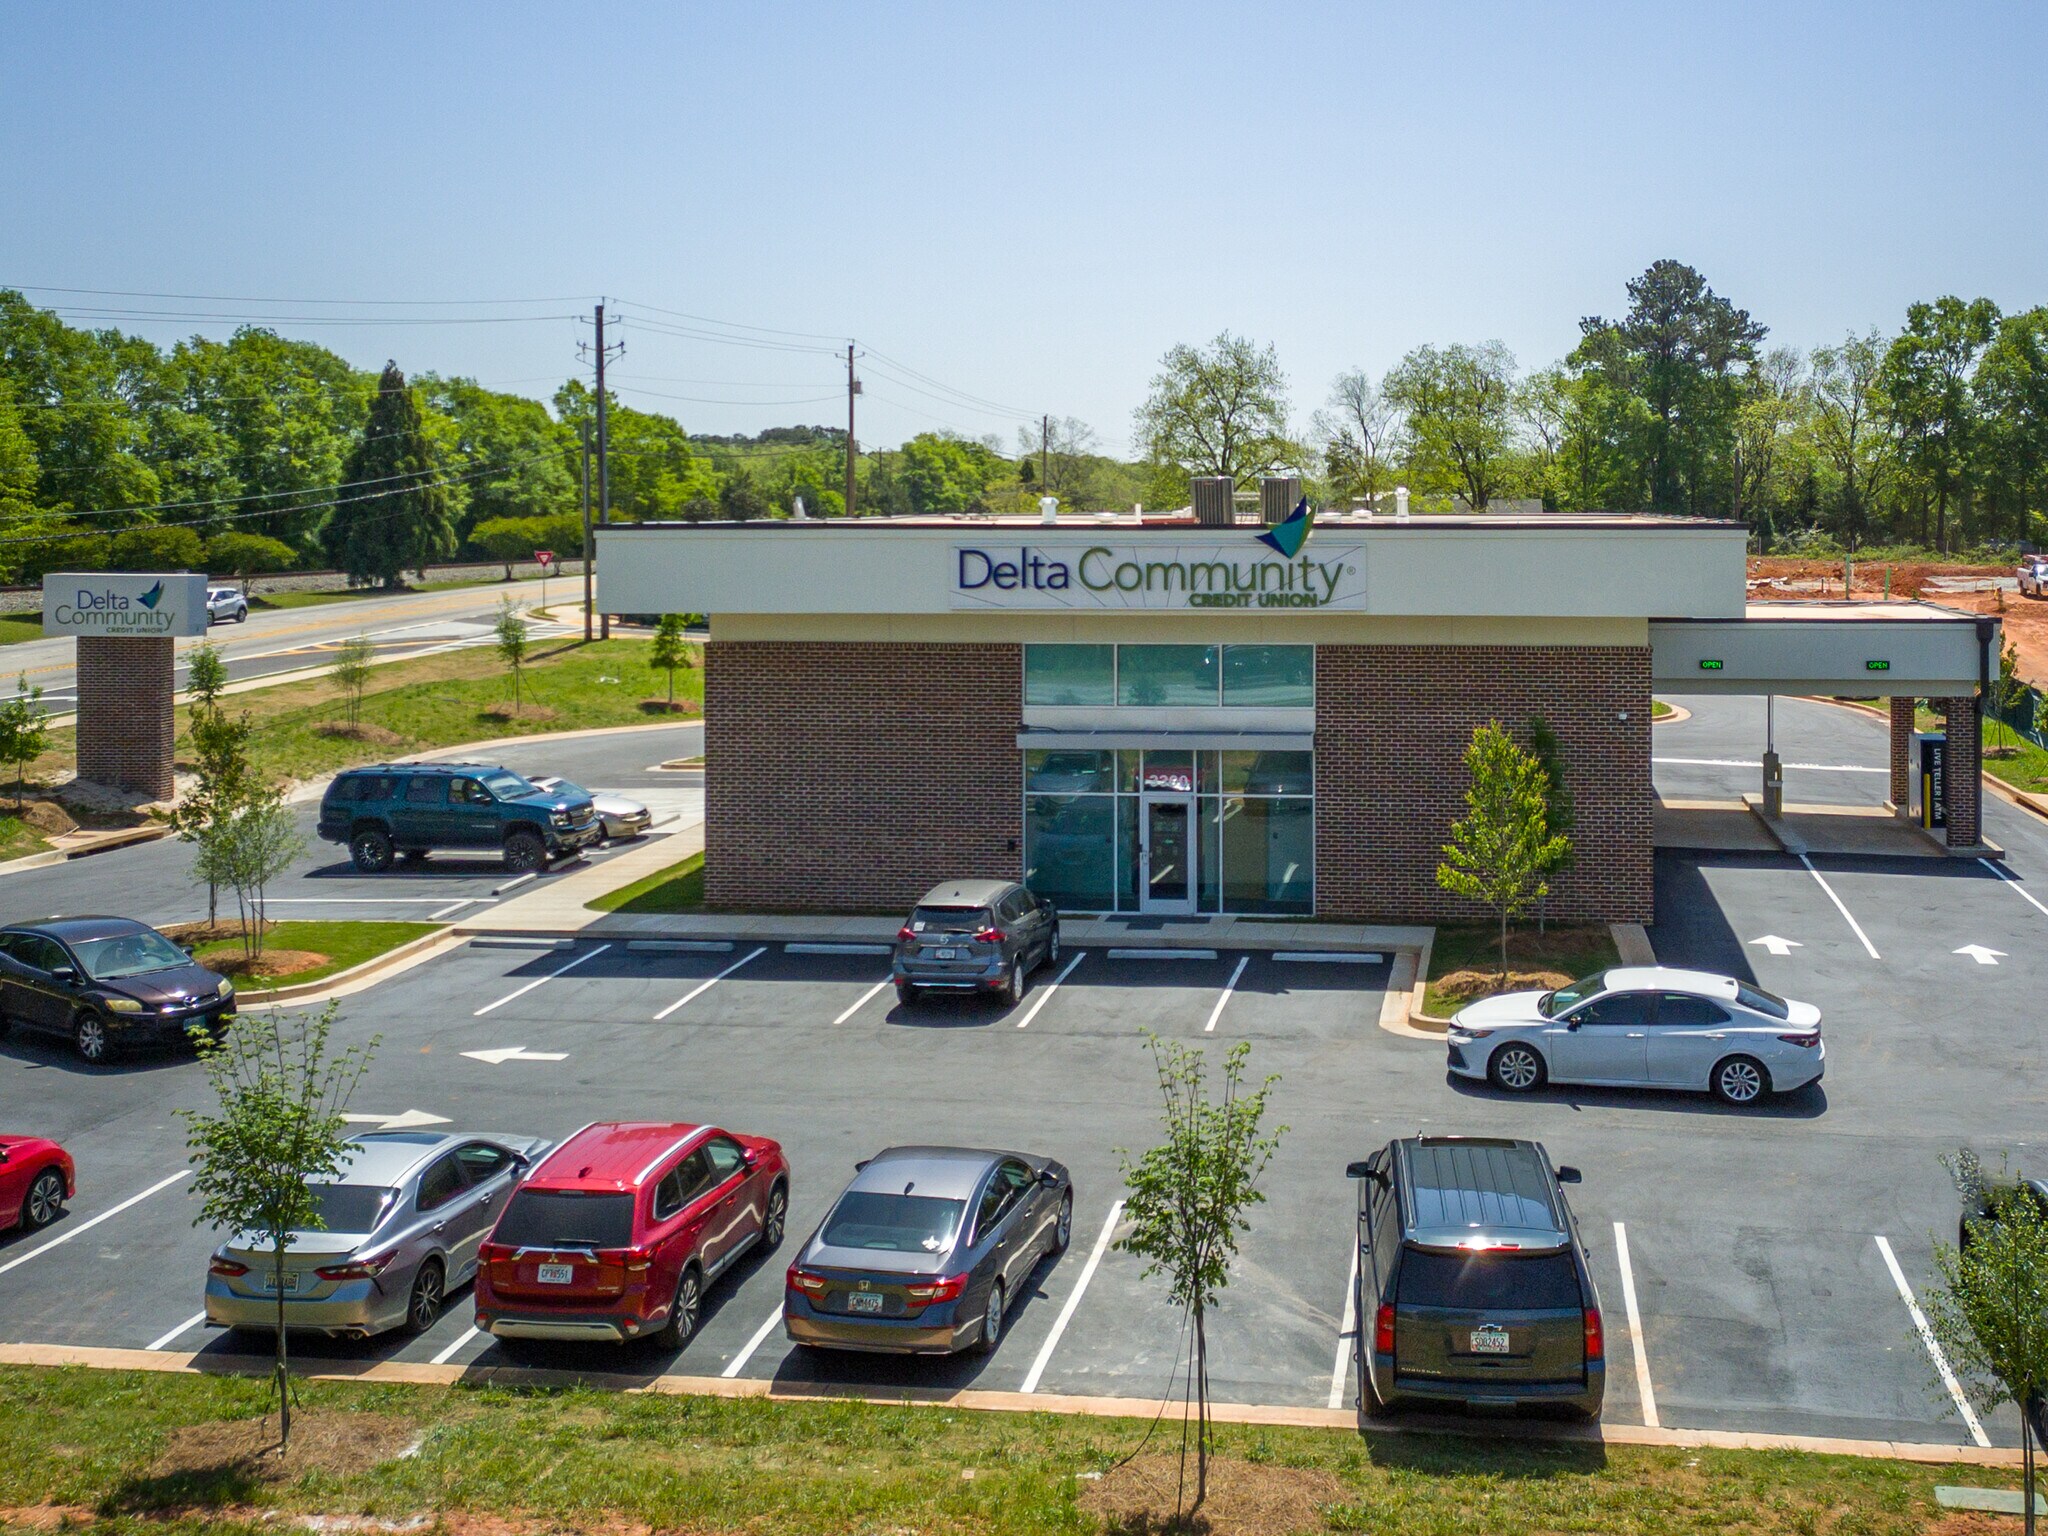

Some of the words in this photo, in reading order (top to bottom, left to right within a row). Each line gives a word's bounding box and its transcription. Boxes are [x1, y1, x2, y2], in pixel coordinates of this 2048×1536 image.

[958, 546, 1070, 591] Delta
[1078, 546, 1344, 605] Community
[77, 589, 130, 610] Delta
[1188, 592, 1252, 608] CREDIT
[1257, 592, 1319, 608] UNION
[55, 604, 176, 631] Community
[106, 626, 134, 634] CREDIT
[1702, 661, 1722, 669] OPEN
[1868, 661, 1888, 669] OPEN
[1933, 748, 1942, 766] LIVE
[1932, 767, 1942, 797] TELLER
[1934, 801, 1942, 820] ATM
